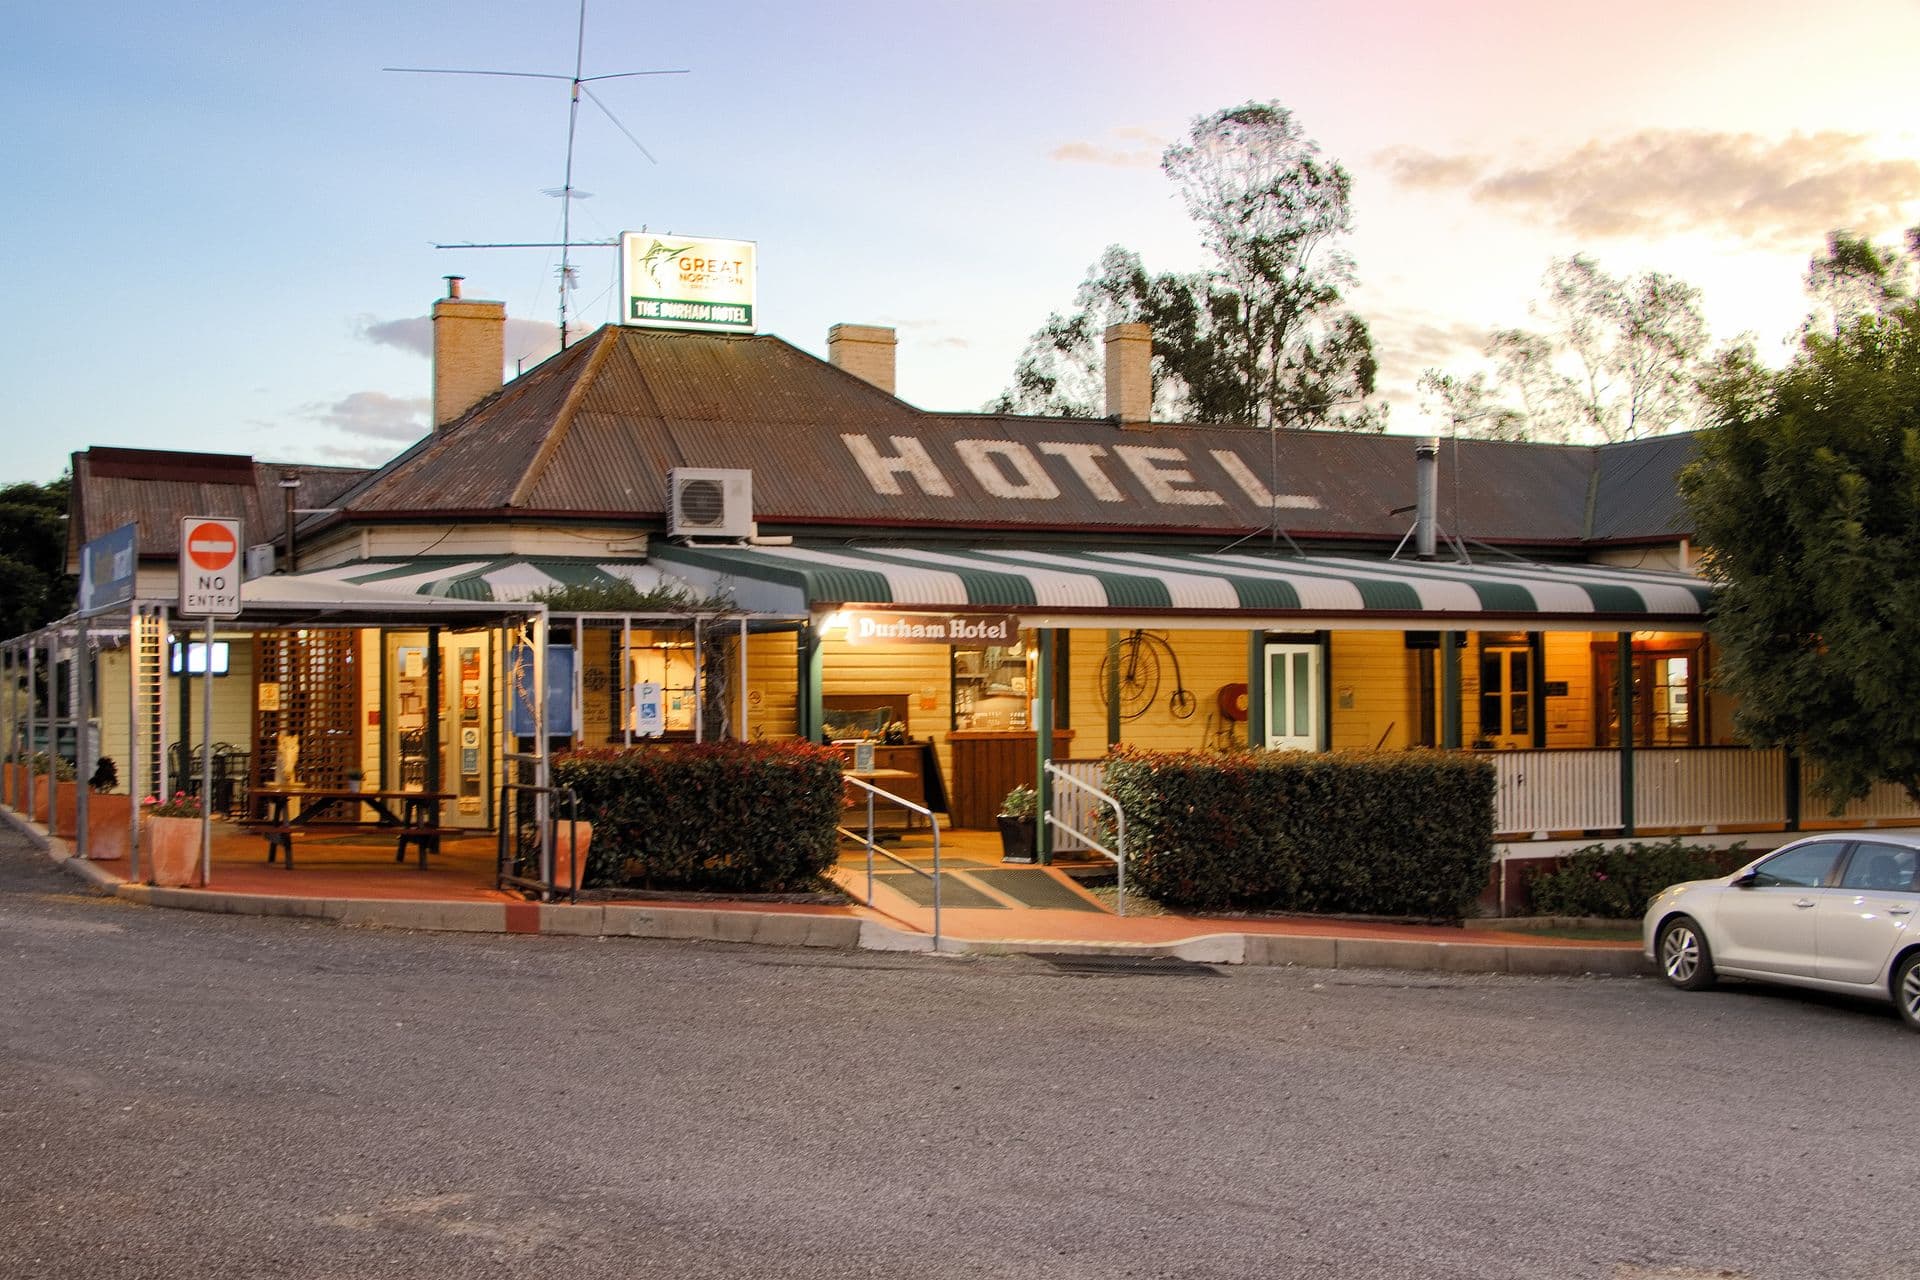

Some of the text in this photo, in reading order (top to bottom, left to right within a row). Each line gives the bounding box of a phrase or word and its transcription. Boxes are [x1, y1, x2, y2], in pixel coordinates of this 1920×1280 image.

[679, 257, 743, 274] GREAT
[636, 300, 748, 323] THE DURHAM HOTEL
[840, 433, 1320, 509] HOTEL
[199, 576, 225, 590] NO
[188, 594, 236, 607] ENTRY
[859, 617, 1008, 640] Durham Hotel
